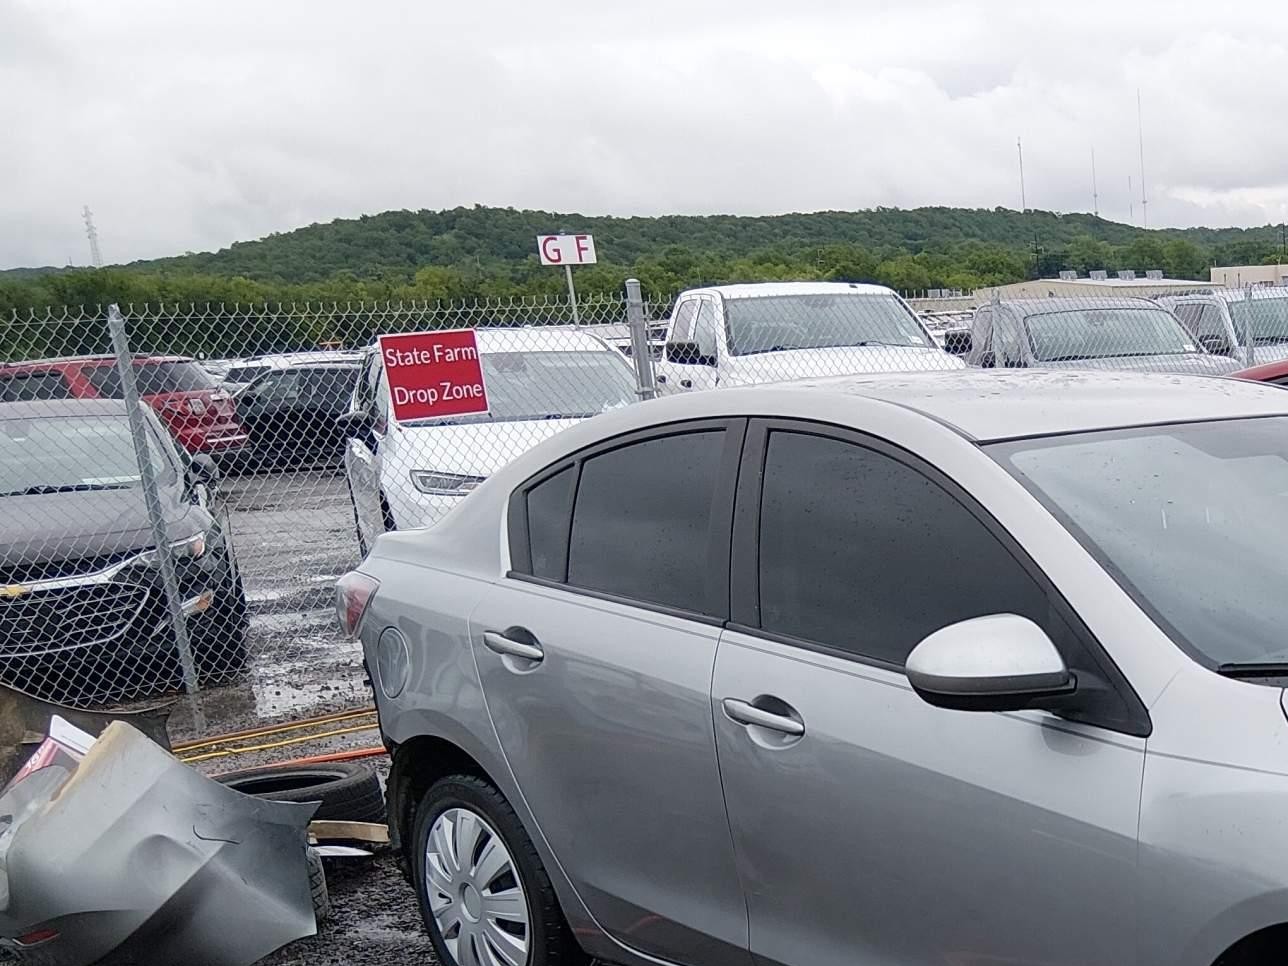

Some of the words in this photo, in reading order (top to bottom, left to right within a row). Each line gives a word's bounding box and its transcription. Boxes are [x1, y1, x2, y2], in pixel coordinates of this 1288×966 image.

[542, 236, 562, 263] G
[575, 236, 588, 262] F
[385, 346, 431, 368] State
[433, 344, 477, 363] Farm
[394, 385, 439, 406] Drop
[440, 381, 483, 401] Zone
